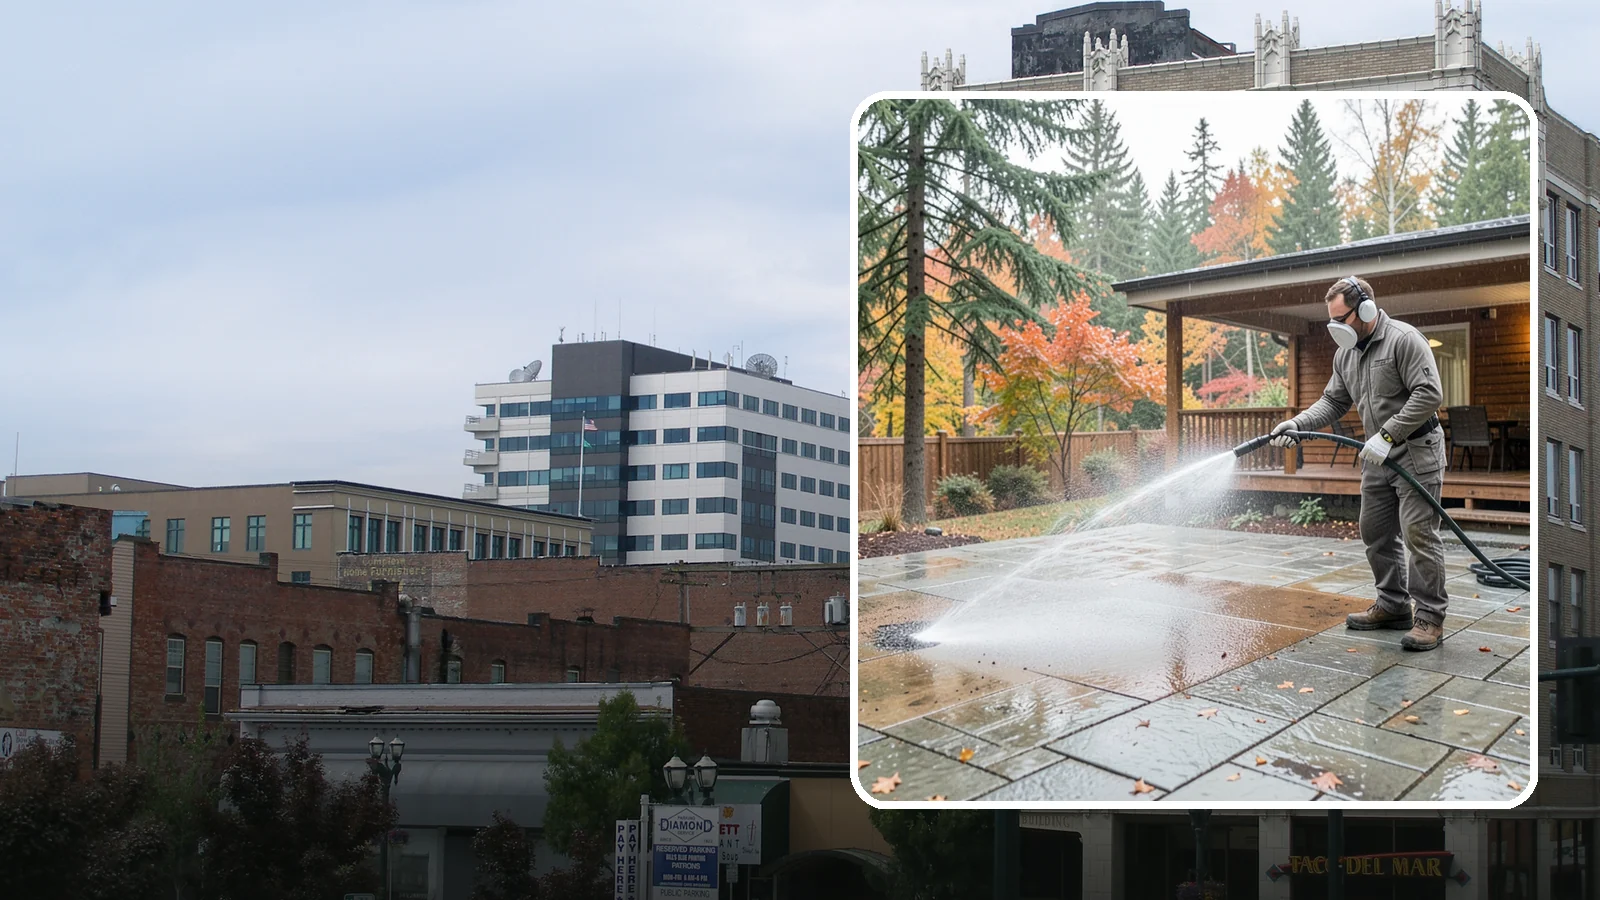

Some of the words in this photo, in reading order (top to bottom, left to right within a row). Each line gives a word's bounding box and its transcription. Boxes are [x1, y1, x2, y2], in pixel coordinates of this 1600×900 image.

[343, 568, 367, 577] Home
[370, 566, 427, 577] Furnishers
[660, 818, 713, 833] DIAMOND
[1022, 815, 1069, 828] BUILDING
[719, 824, 740, 835] ETT
[617, 825, 625, 852] PAY
[628, 824, 637, 852] PAY
[719, 839, 740, 848] ANT
[656, 845, 688, 853] RESERVED
[689, 846, 716, 854] PARKING
[721, 851, 739, 862] Soup
[671, 862, 701, 870] PATRONS
[1290, 855, 1329, 874] TAC
[1346, 856, 1385, 876] DEL
[1392, 857, 1442, 877] MAR
[616, 856, 625, 893] HERE
[627, 855, 637, 893] HERE
[660, 888, 682, 897] PUBLIC
[683, 889, 710, 898] PARKING
